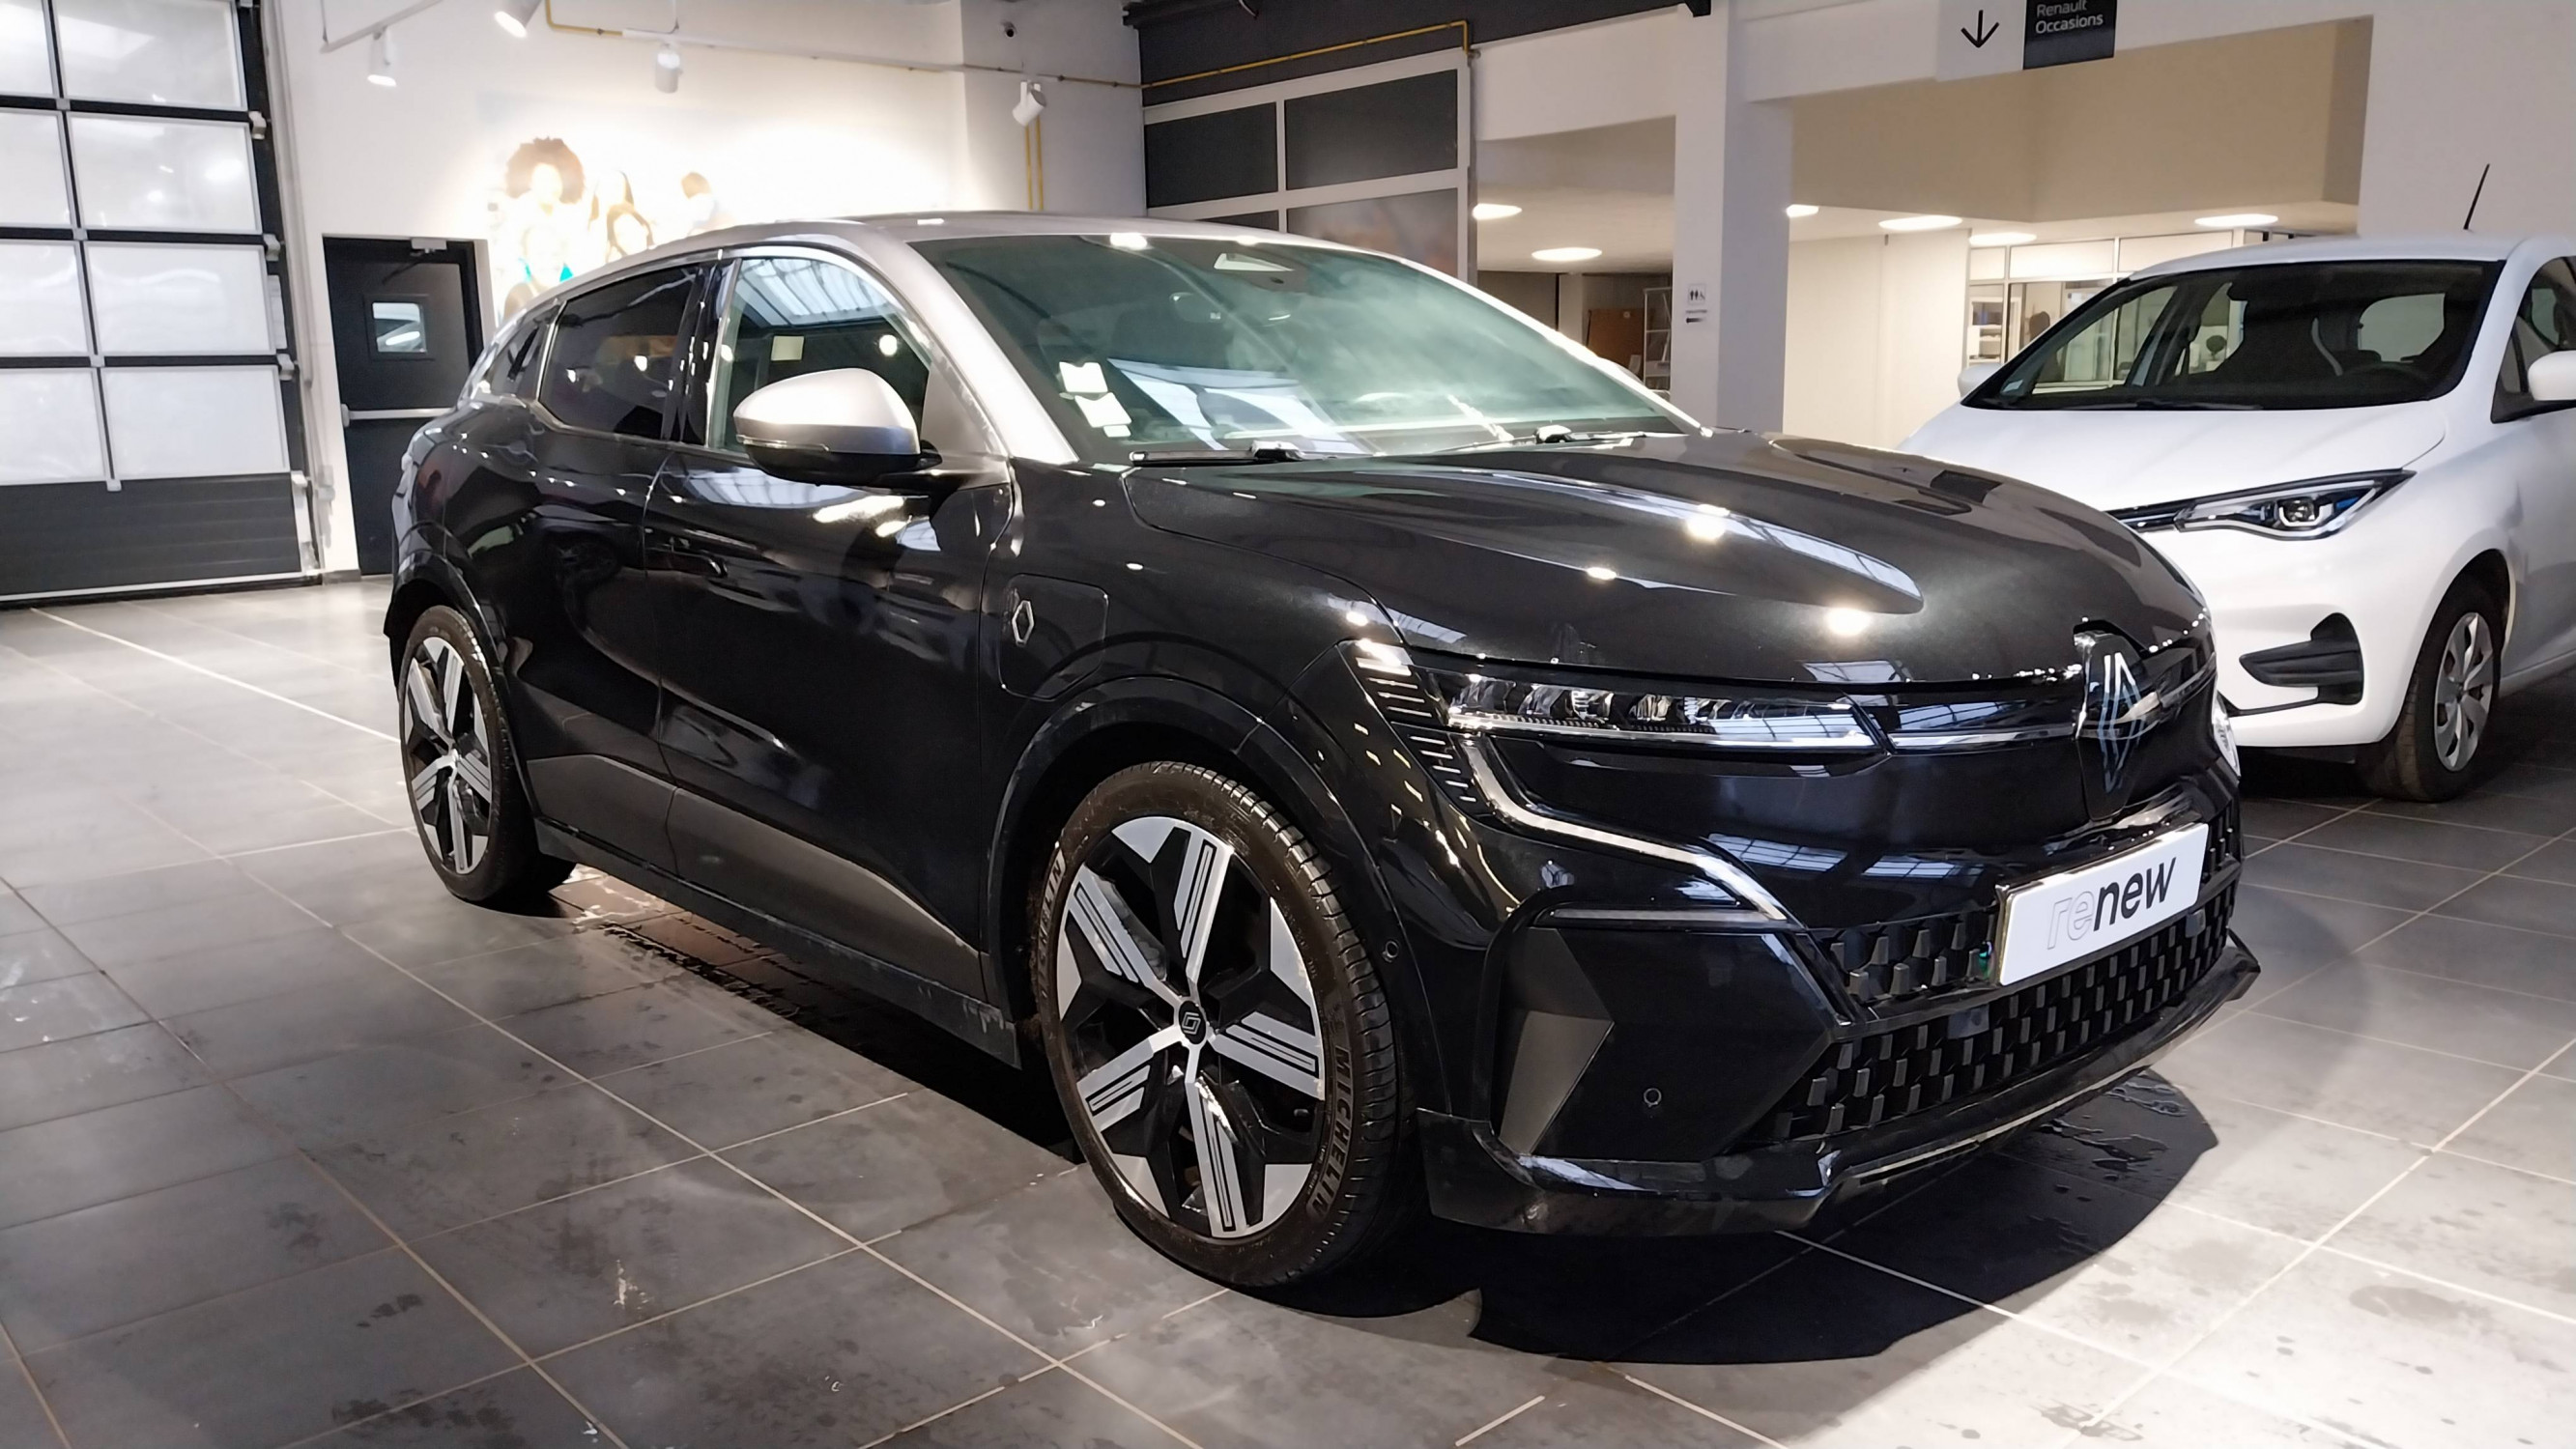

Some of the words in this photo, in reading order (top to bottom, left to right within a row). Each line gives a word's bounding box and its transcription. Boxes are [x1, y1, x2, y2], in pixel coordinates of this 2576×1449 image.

[2035, 14, 2104, 34] Occasions
[2036, 0, 2087, 18] Renault
[2046, 857, 2177, 951] renew
[1312, 1047, 1351, 1217] MICHELIN
